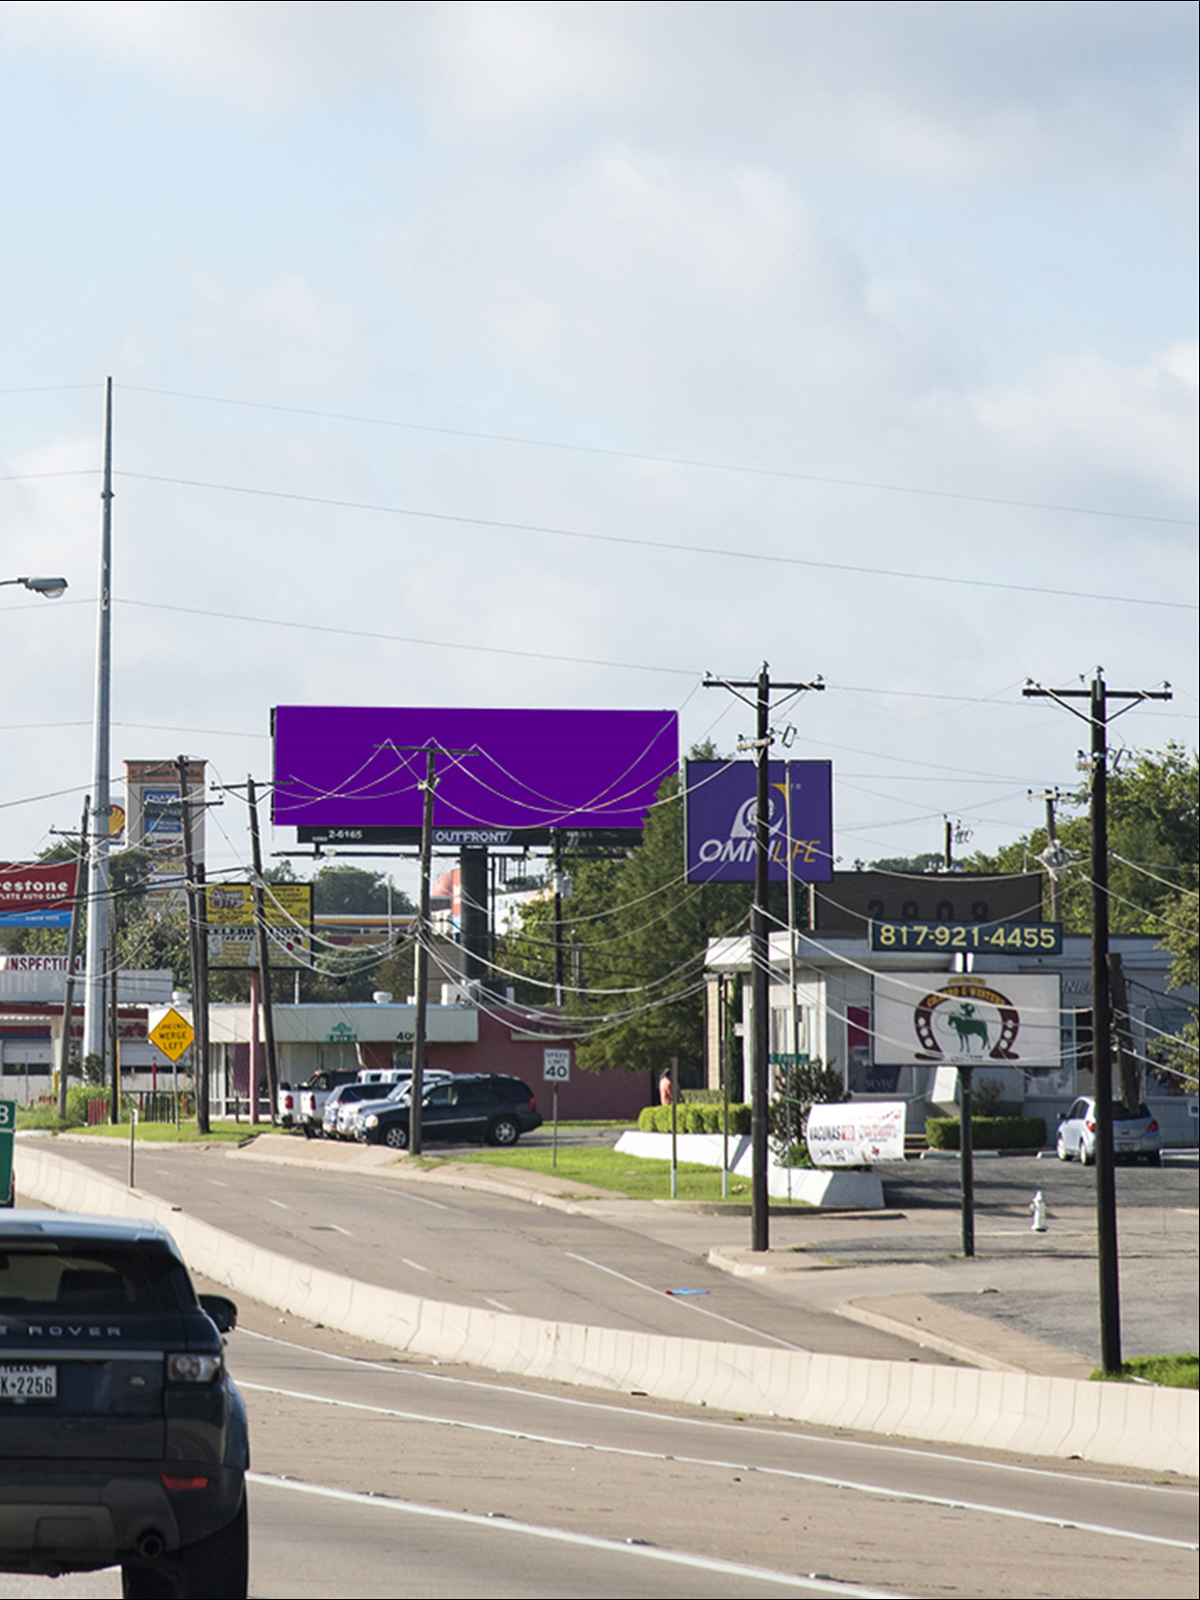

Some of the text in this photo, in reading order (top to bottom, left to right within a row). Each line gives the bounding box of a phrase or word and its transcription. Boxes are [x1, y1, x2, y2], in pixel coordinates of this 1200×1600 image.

[328, 829, 362, 839] 2-6165
[435, 830, 508, 843] OUTFRONT
[699, 839, 821, 862] OMNILFE
[23, 892, 44, 900] AUTO
[879, 925, 1056, 948] 817-921-4455
[159, 1031, 187, 1040] MERGE
[163, 1041, 184, 1050] LEFT
[545, 1065, 567, 1078] 40
[28, 1325, 122, 1337] ROVER
[3, 1365, 35, 1374] TEXAS
